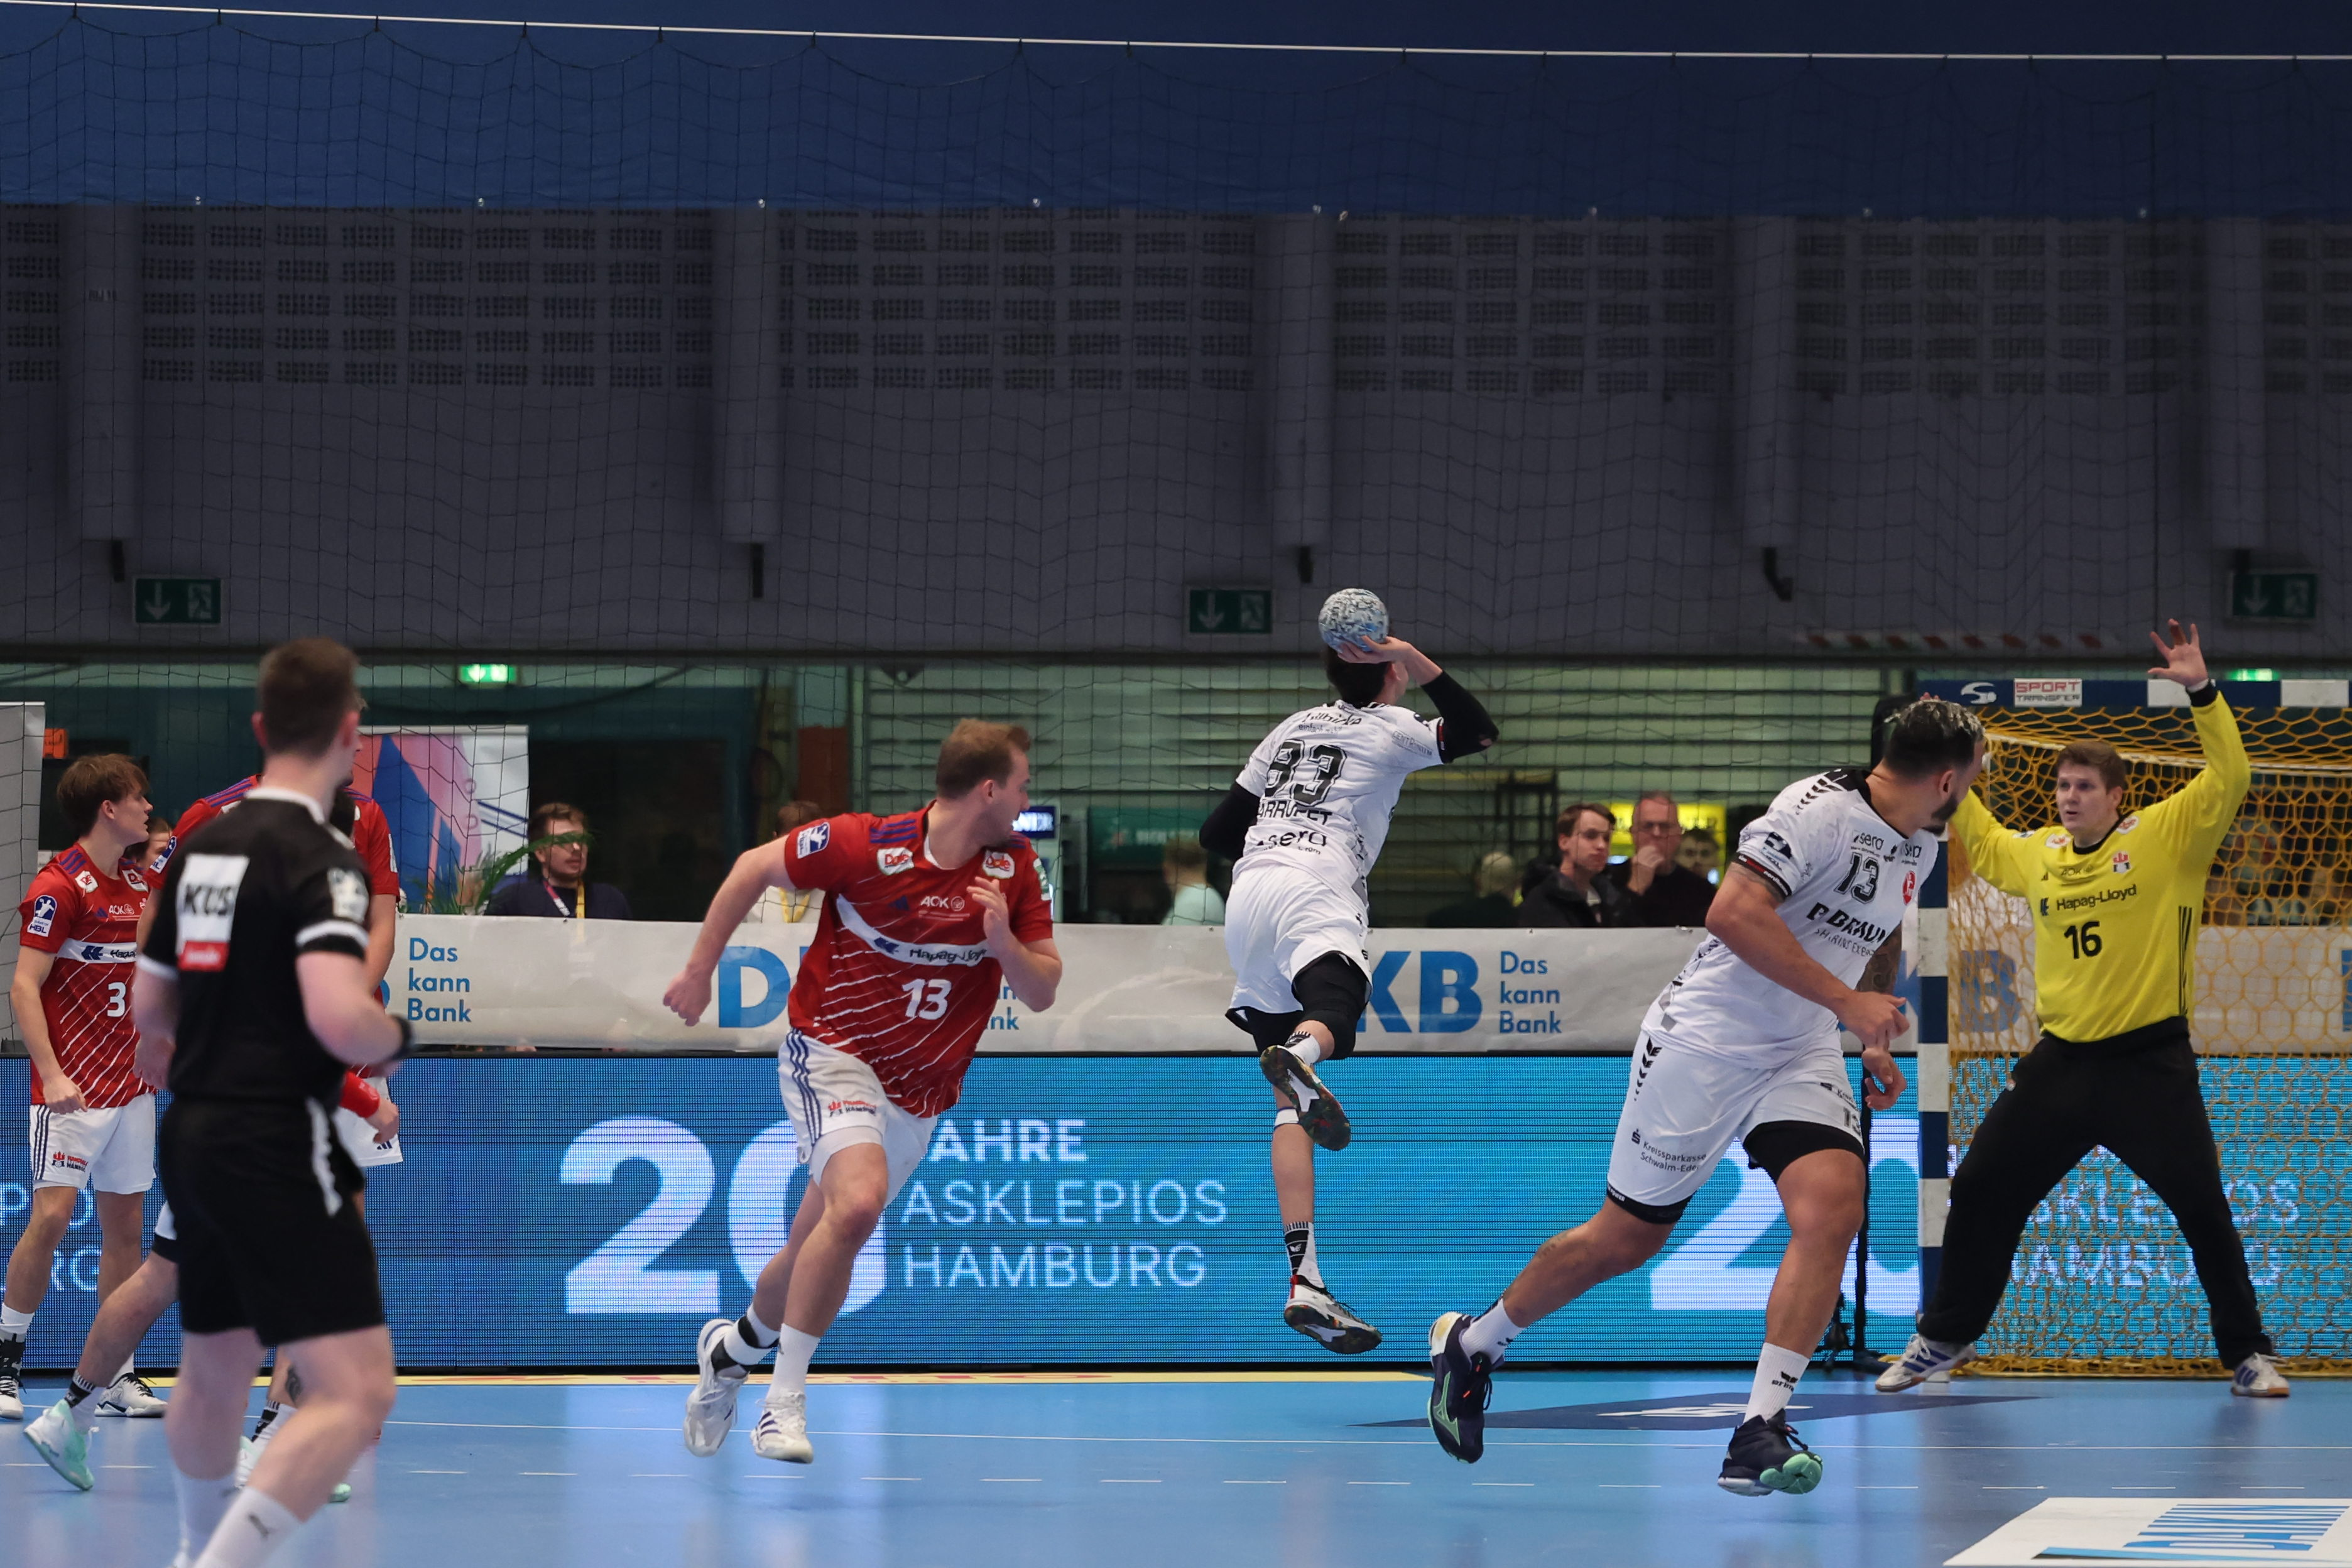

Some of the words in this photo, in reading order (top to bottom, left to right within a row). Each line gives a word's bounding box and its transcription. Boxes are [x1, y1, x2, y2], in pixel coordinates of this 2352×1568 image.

[2016, 682, 2081, 692] SPORT
[1859, 832, 1884, 851] sera
[1834, 852, 1880, 904] 13
[920, 896, 949, 908] AOK
[2057, 883, 2137, 911] Hapag-Lloyd
[109, 905, 126, 915] AOK
[30, 923, 46, 934] HBL
[2064, 921, 2103, 959] 16
[409, 937, 458, 962] Das
[1500, 951, 1548, 974] Das
[408, 967, 471, 992] kann
[107, 981, 126, 1018] 3
[901, 979, 952, 1020] 13
[1356, 951, 1483, 1033] KB
[1500, 981, 1560, 1004] kann
[407, 998, 472, 1022] Bank
[986, 1006, 1019, 1030] nk
[1500, 1011, 1562, 1034] Bank
[928, 1119, 1088, 1162] AHRE
[1643, 1141, 1707, 1162] Kreissparkasse
[900, 1180, 1228, 1224] ASKLEPIOS
[903, 1243, 1206, 1287] HAMBURG
